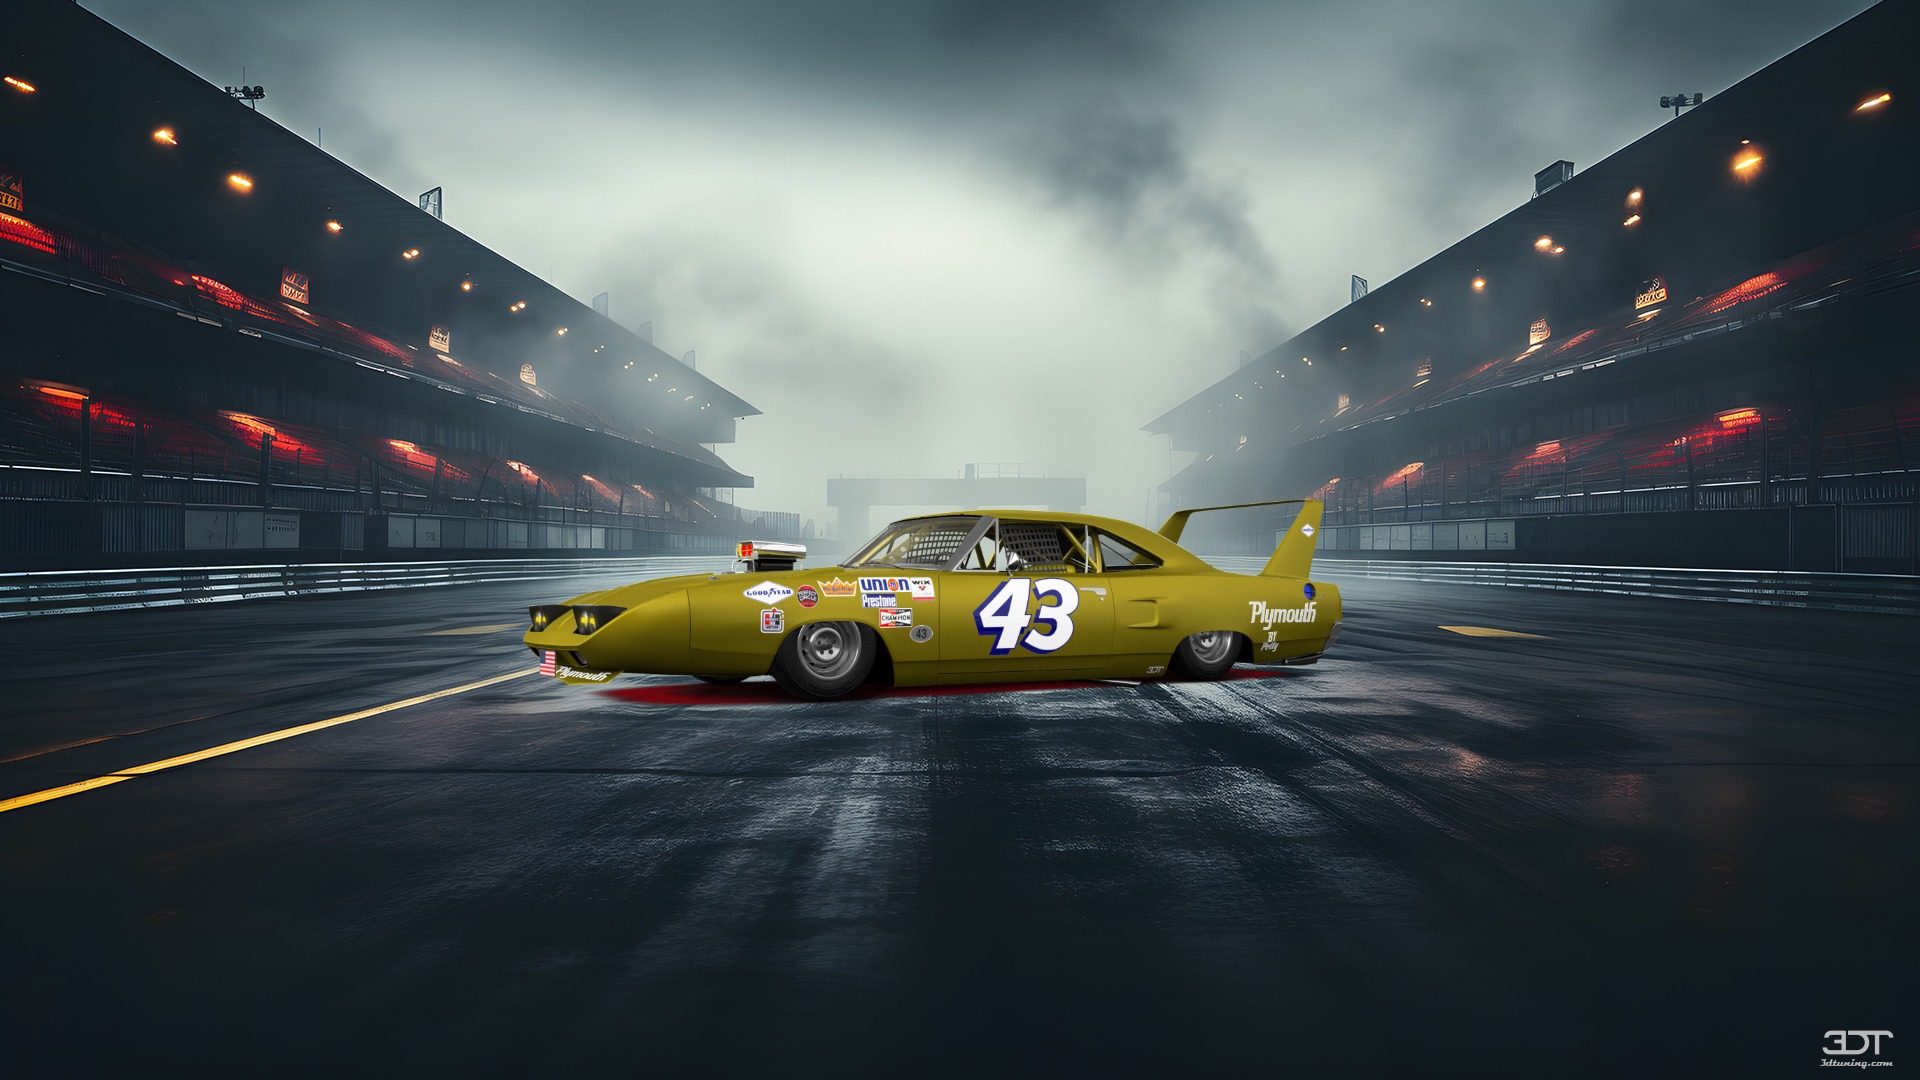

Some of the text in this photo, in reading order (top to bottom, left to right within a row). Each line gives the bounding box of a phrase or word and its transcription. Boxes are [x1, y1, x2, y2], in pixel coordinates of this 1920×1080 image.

[862, 593, 897, 608] Prestone
[973, 578, 1079, 655] 43
[1249, 601, 1317, 630] Plymouth
[915, 628, 927, 639] 43
[1267, 631, 1278, 642] BY
[556, 666, 611, 681] Plymouth
